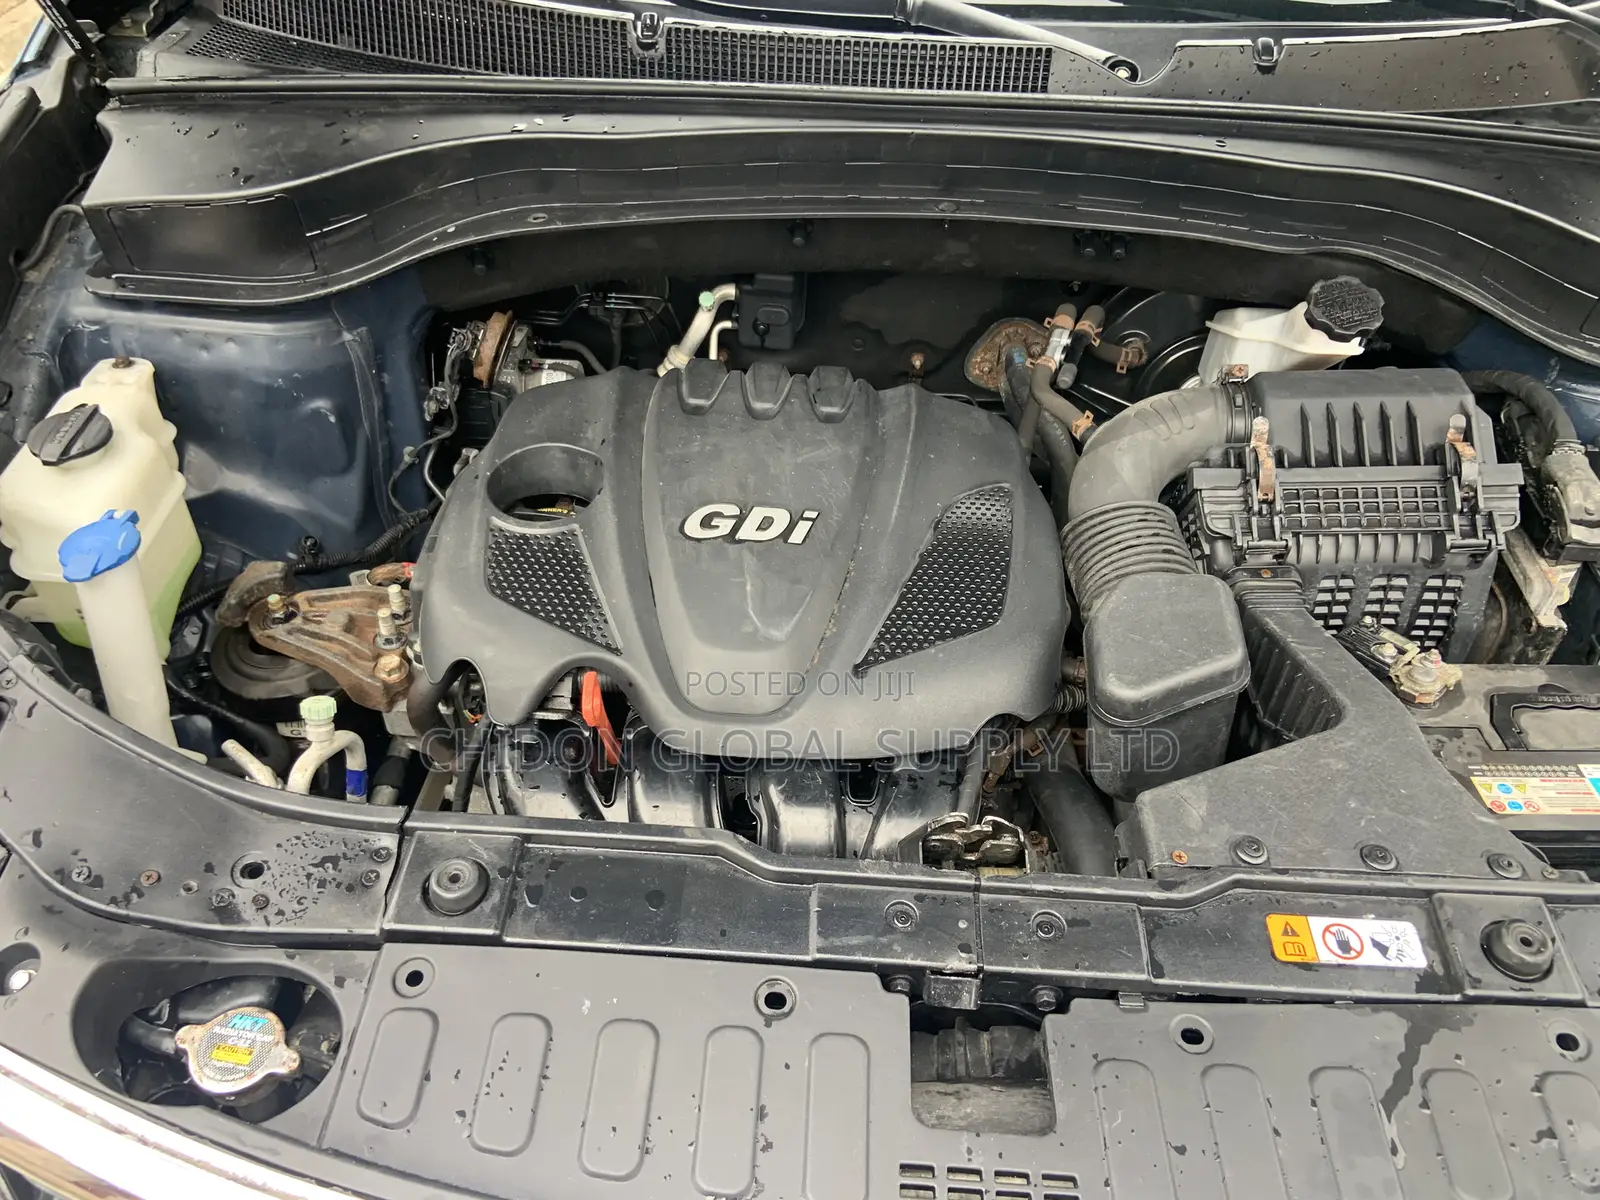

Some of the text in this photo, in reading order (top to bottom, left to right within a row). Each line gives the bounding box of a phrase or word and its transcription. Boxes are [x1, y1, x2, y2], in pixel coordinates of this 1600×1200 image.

[682, 503, 820, 545] GDi
[227, 1014, 269, 1032] HKT
[212, 1026, 256, 1040] RADIATOR
[218, 1045, 252, 1055] CAUTION
